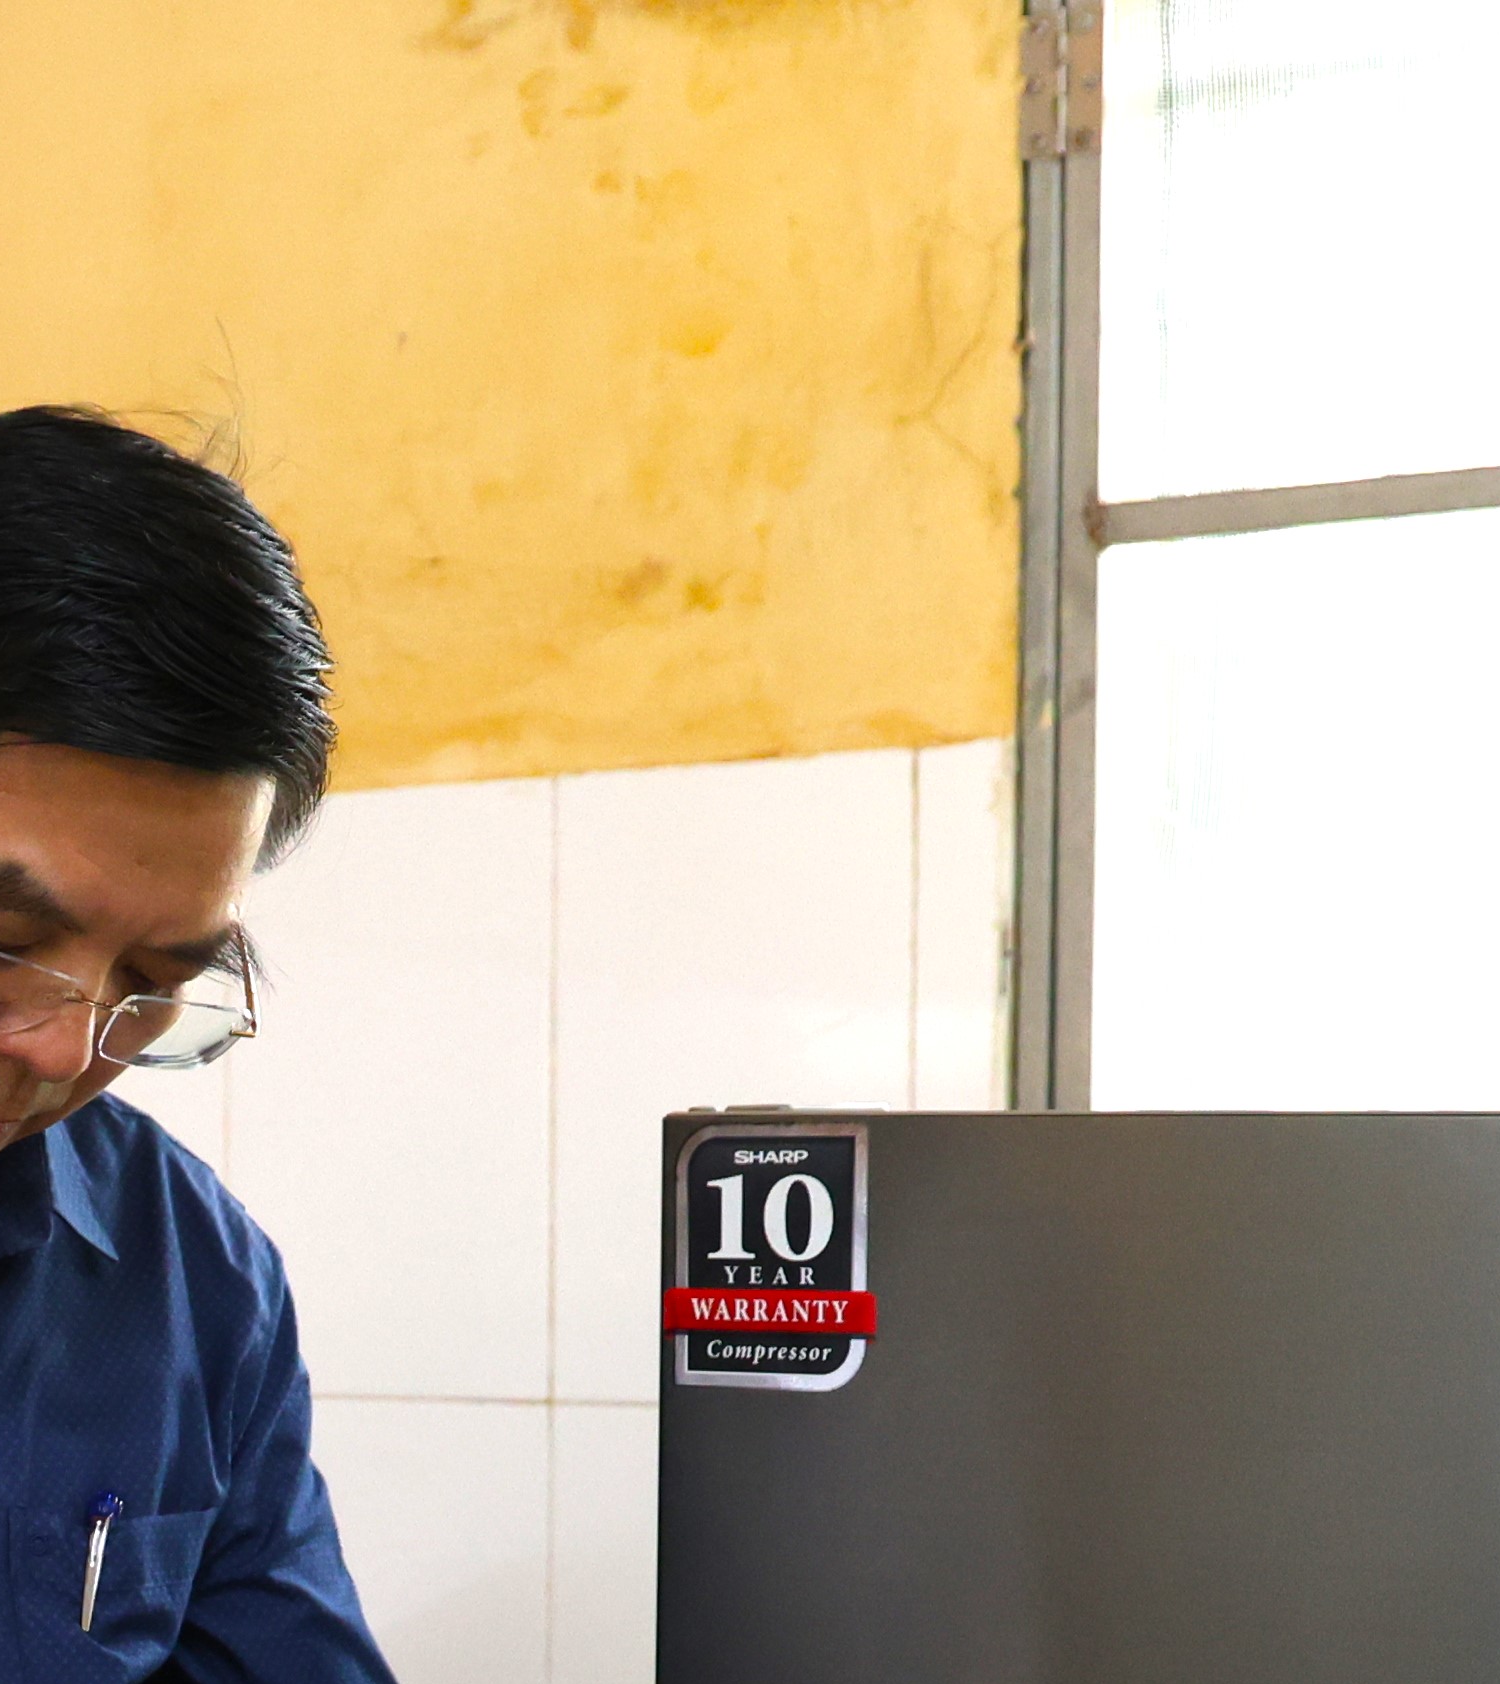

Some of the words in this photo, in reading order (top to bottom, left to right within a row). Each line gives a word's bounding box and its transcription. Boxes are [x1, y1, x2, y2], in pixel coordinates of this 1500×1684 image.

[734, 1149, 809, 1165] SHARP
[706, 1173, 834, 1262] 10
[723, 1265, 816, 1286] YEAR
[690, 1297, 850, 1324] WARRANTY
[705, 1339, 833, 1365] Compressor
